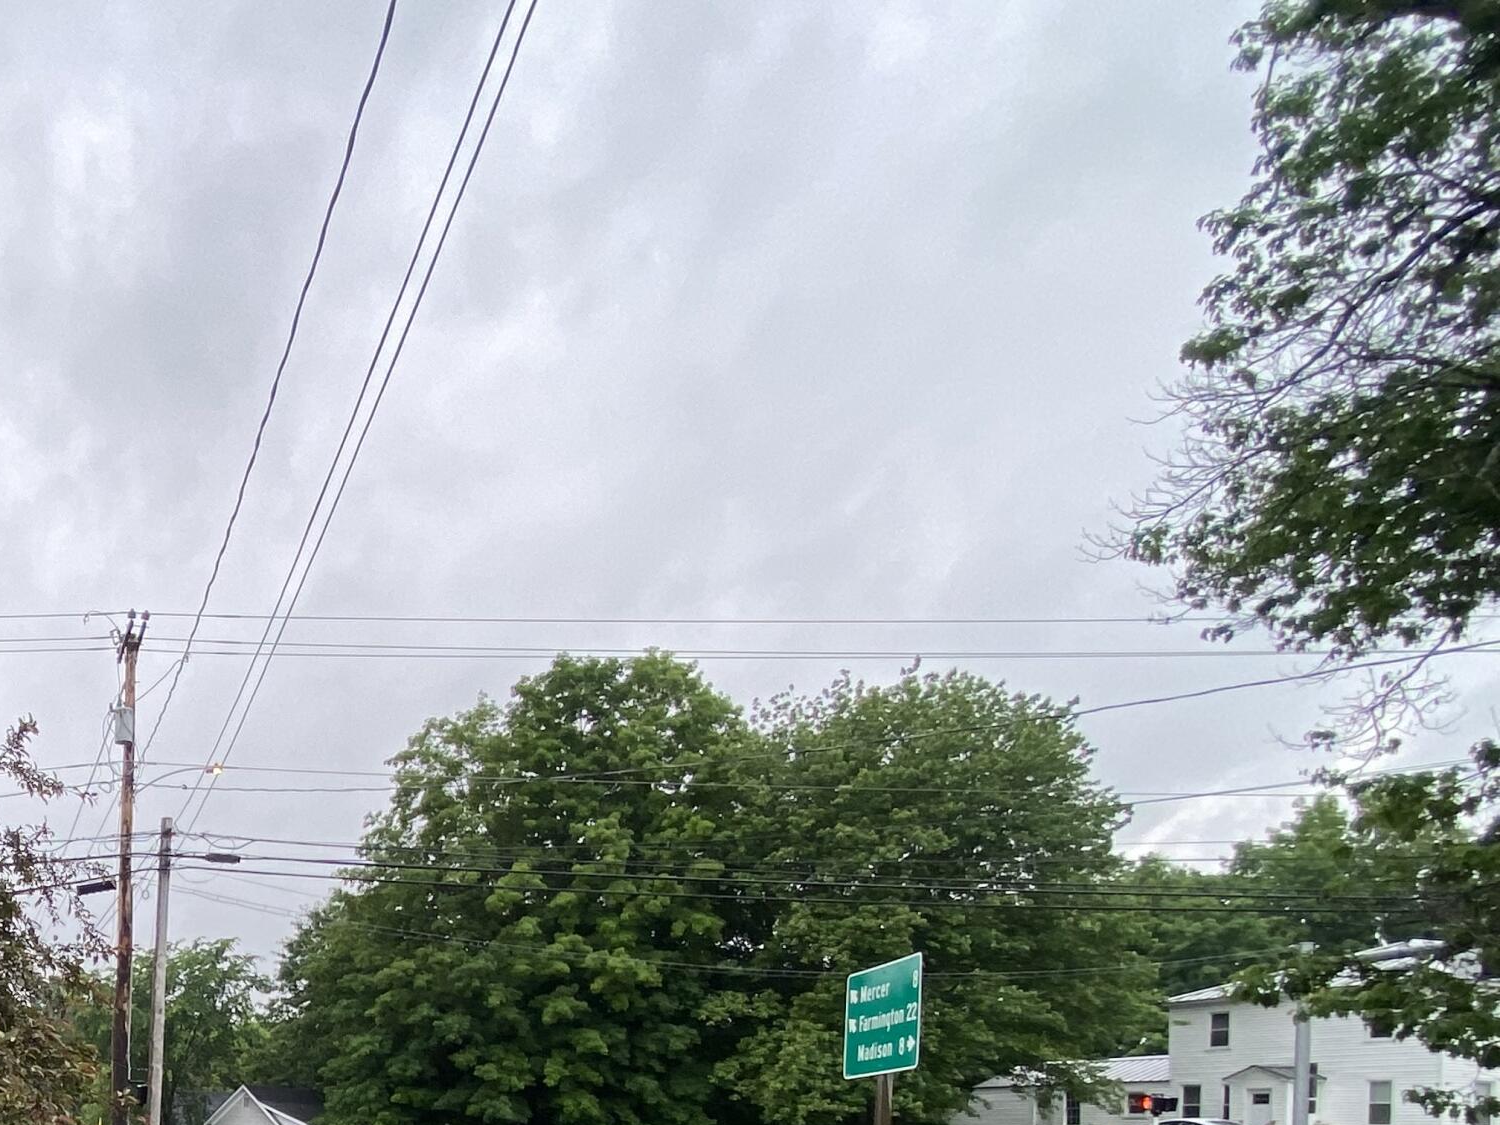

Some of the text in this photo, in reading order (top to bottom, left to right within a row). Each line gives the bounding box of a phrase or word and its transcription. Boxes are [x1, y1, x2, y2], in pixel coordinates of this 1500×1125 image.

[860, 970, 919, 1003] Mercer 8
[858, 1002, 917, 1033] Farmington 22
[857, 1037, 905, 1062] Madison 8
